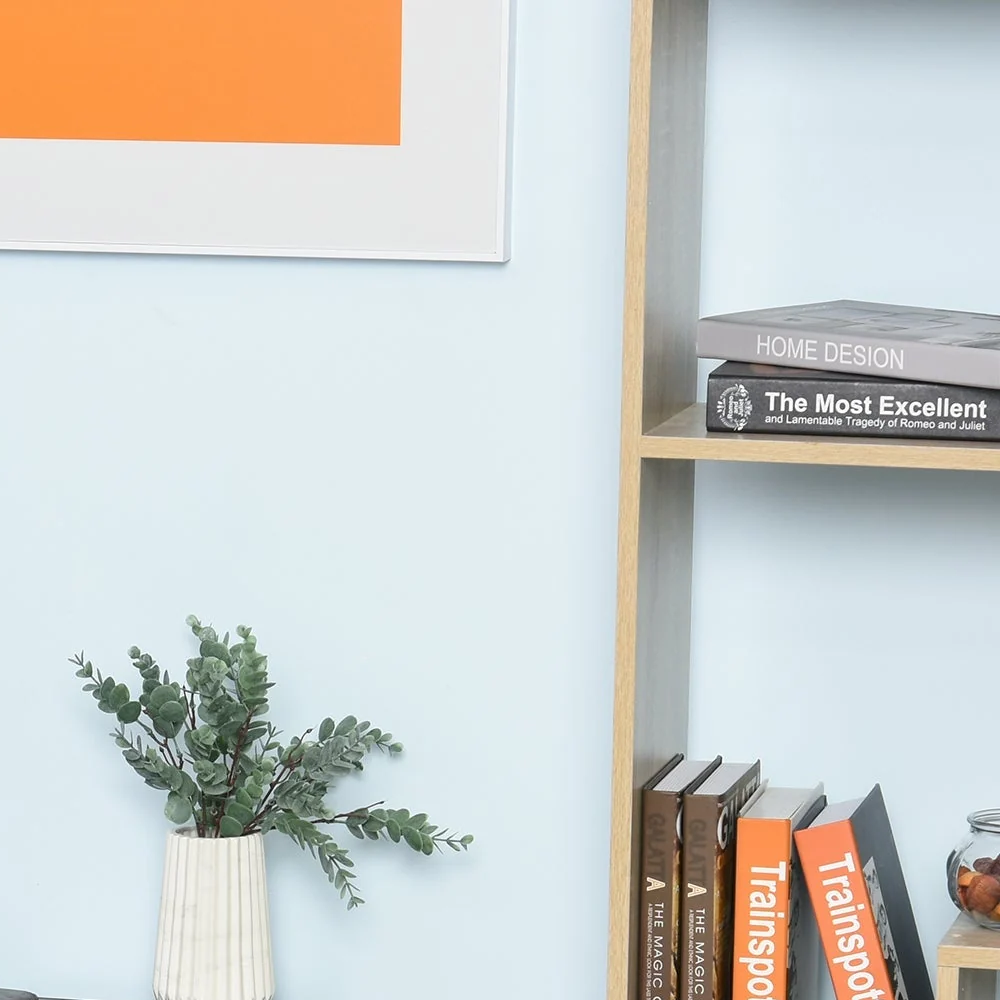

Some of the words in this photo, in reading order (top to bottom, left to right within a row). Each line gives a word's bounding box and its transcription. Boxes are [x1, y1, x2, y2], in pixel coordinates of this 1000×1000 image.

[756, 334, 818, 361] HOME
[765, 392, 808, 413] The
[815, 393, 872, 415] Most
[879, 396, 987, 418] Excellent
[765, 414, 783, 424] and
[786, 414, 843, 426] Lamentable
[846, 416, 885, 429] Tragedy
[888, 417, 898, 427] of
[900, 418, 935, 429] Romeo
[937, 419, 956, 430] and
[958, 420, 986, 431] Juliet
[654, 902, 664, 928] THE
[695, 908, 705, 934] THE
[653, 936, 663, 988] MAGIC
[695, 941, 705, 995] MAGIC
